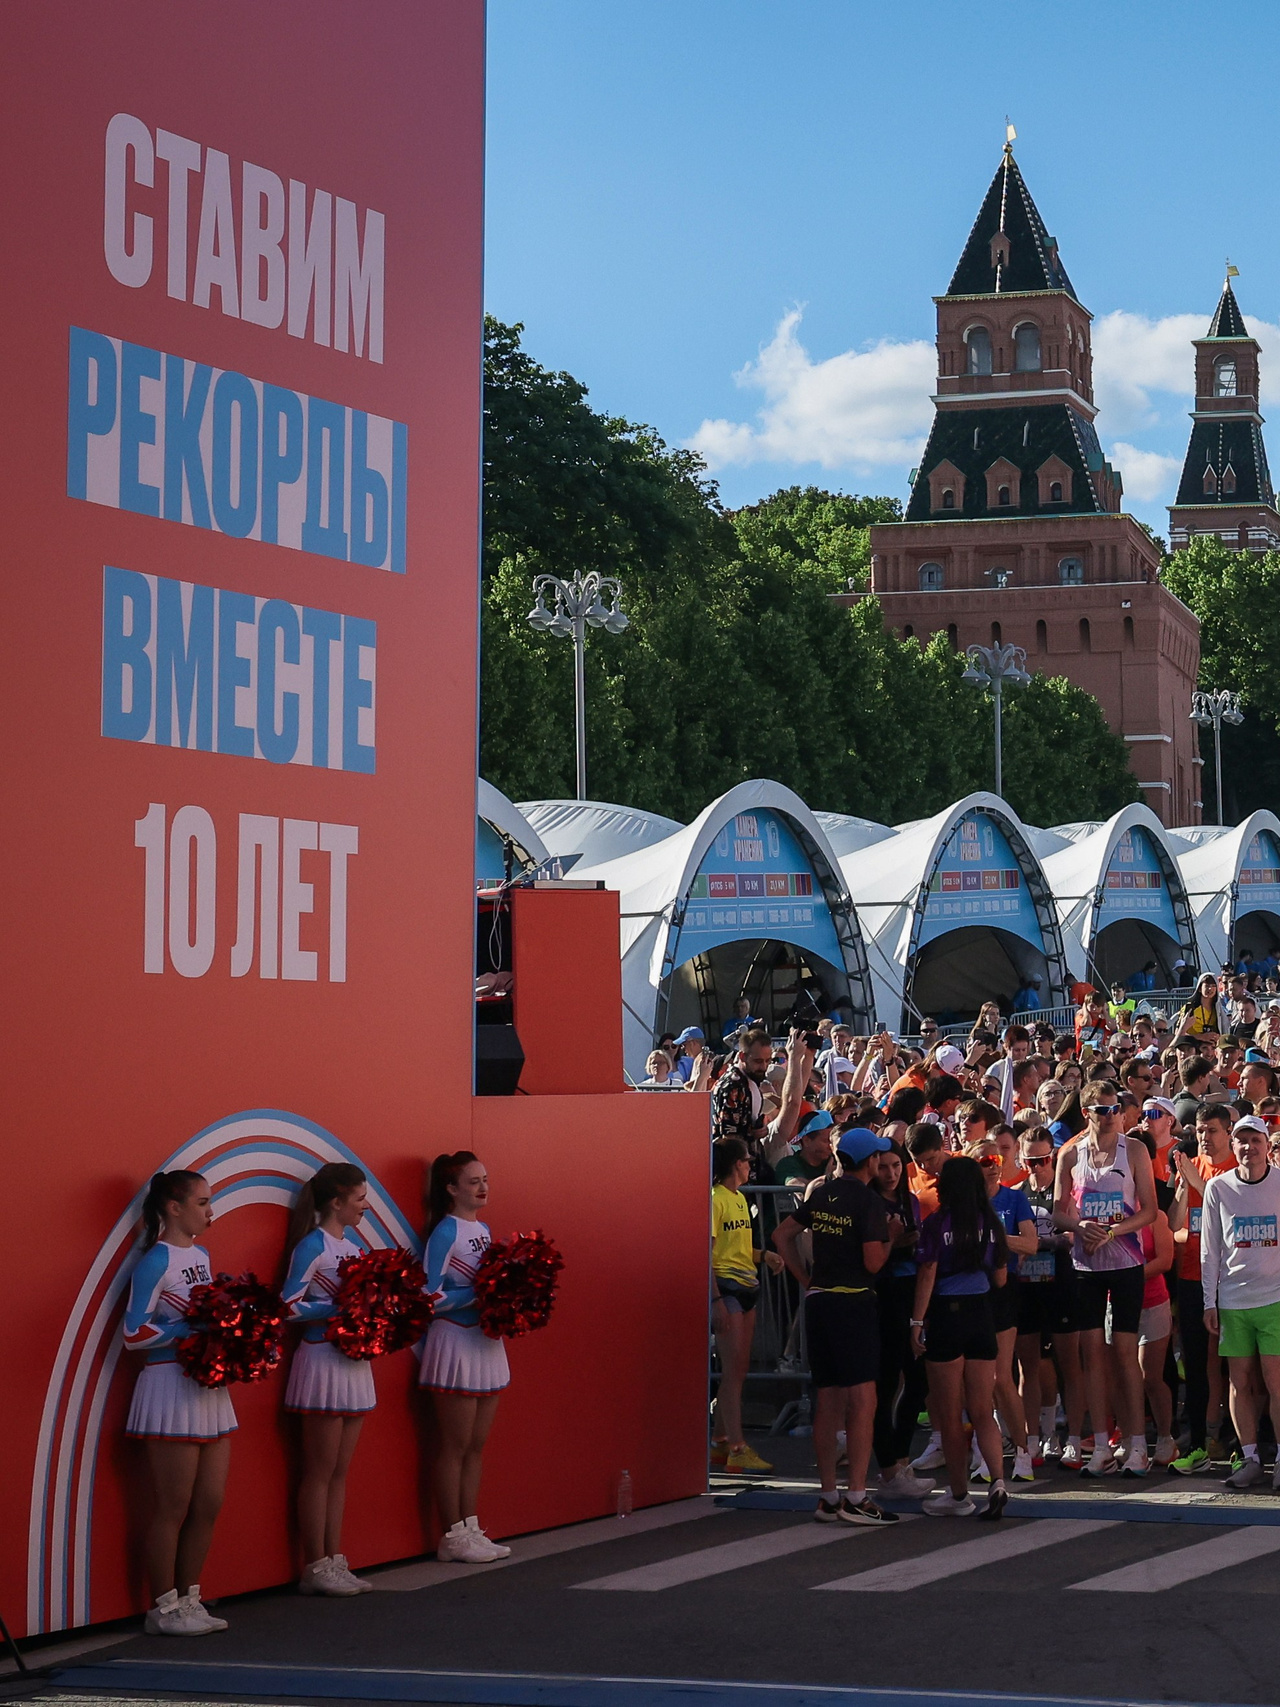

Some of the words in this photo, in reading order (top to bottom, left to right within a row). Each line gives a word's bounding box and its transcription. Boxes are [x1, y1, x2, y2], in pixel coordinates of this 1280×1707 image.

[104, 112, 385, 364] СТАВИМ
[67, 325, 407, 574] РЕКОРДЫ
[102, 565, 376, 774] ВМЕСТЕ
[135, 803, 216, 978] 10
[231, 812, 359, 982] ЛЕТ
[1084, 1200, 1121, 1217] 37245
[1236, 1224, 1275, 1240] 40838
